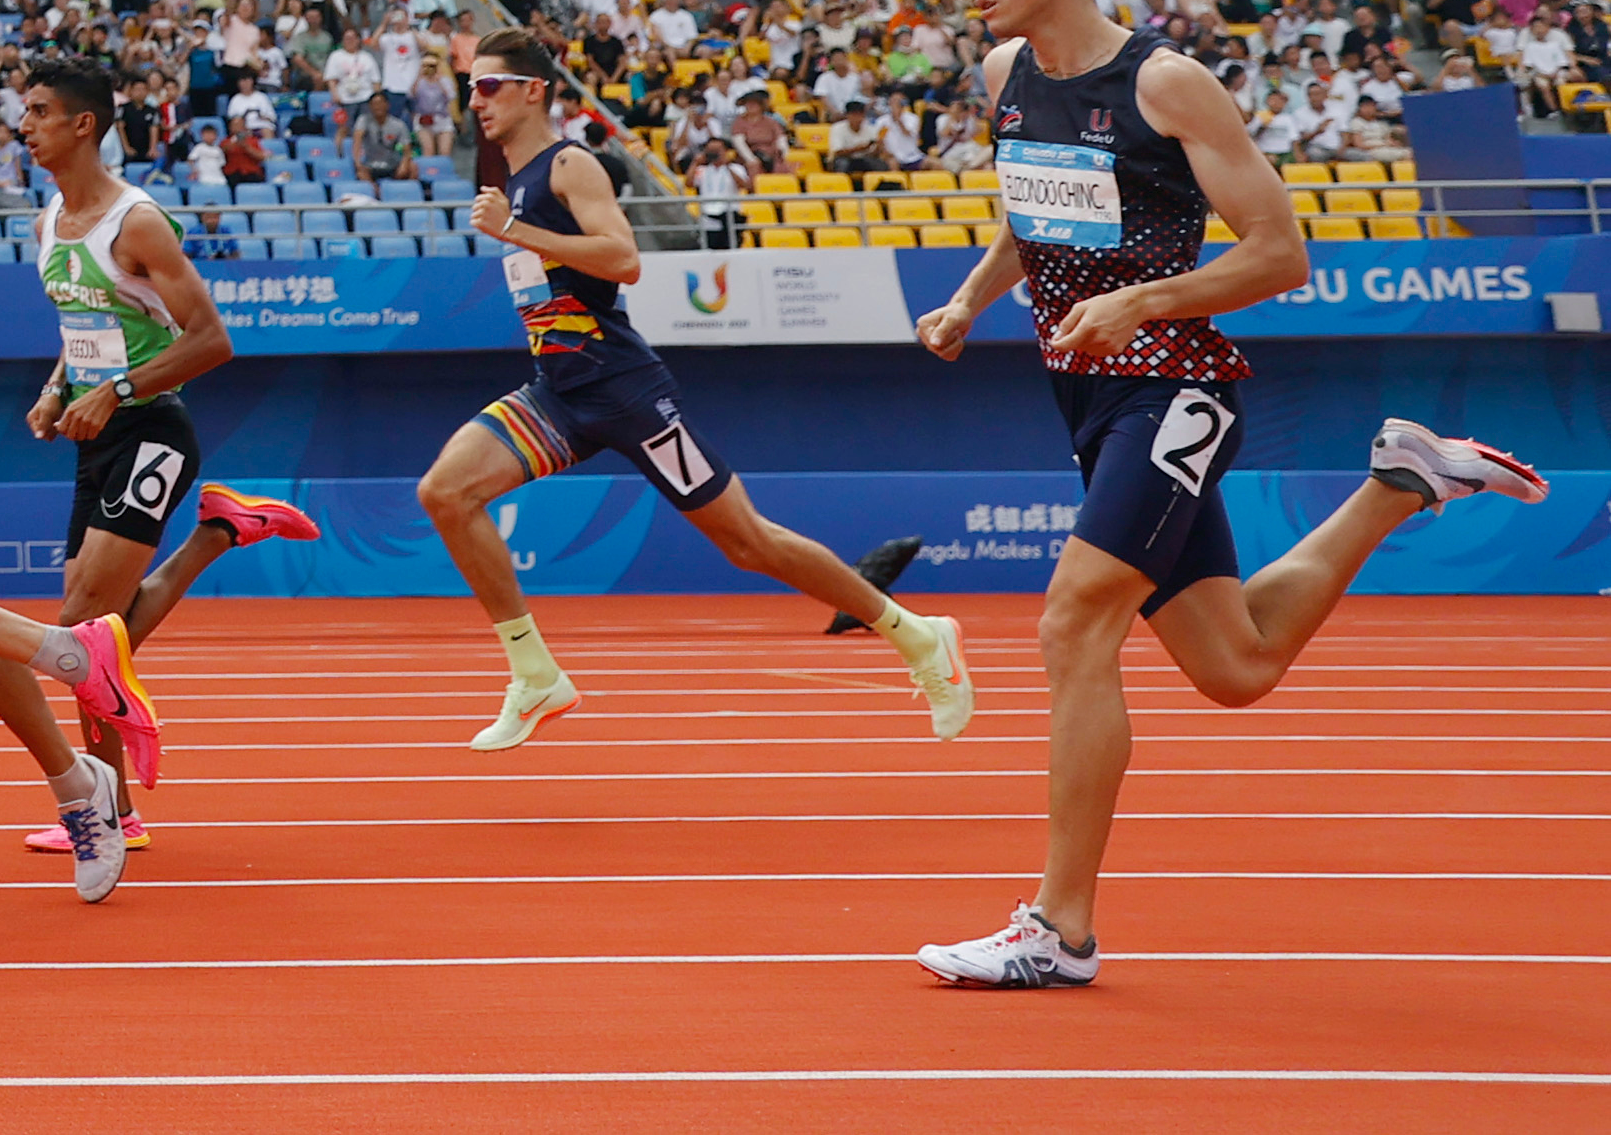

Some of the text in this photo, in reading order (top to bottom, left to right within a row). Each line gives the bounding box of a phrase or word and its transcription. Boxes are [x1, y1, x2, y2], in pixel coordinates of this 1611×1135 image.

[1079, 131, 1115, 144] FedeU
[1362, 265, 1532, 302] GAMES
[259, 309, 326, 328] Dreams
[328, 307, 380, 327] Come
[382, 308, 420, 325] True
[648, 426, 693, 487] 7
[1164, 402, 1222, 485] 2
[131, 449, 173, 509] 6
[974, 539, 1042, 560] Makes
